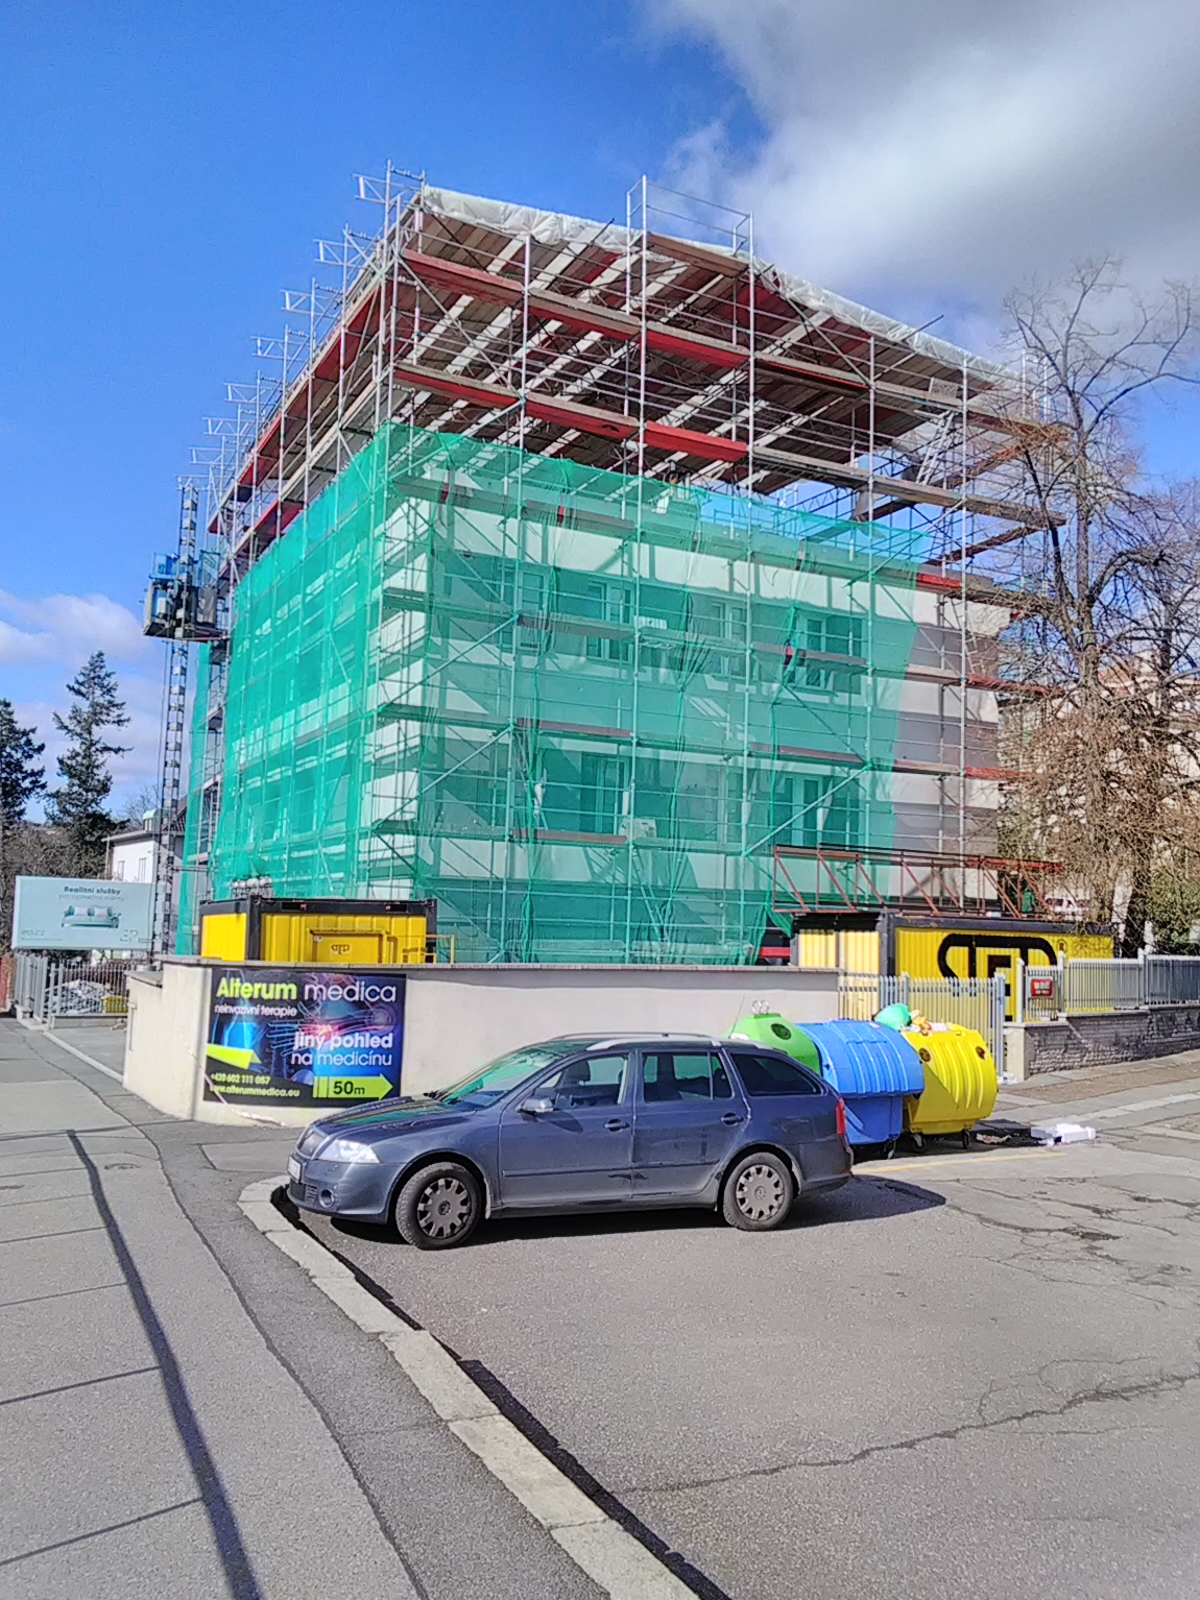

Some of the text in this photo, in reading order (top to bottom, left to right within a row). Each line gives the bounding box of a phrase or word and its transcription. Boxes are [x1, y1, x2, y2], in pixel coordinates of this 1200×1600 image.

[64, 886, 121, 896] Realitní služby
[216, 977, 397, 1002] Alterum medica
[214, 1003, 298, 1018] neinvazivní terapie
[330, 1032, 394, 1050] pohled
[291, 1052, 393, 1066] na medicínu
[241, 1074, 254, 1085] 111
